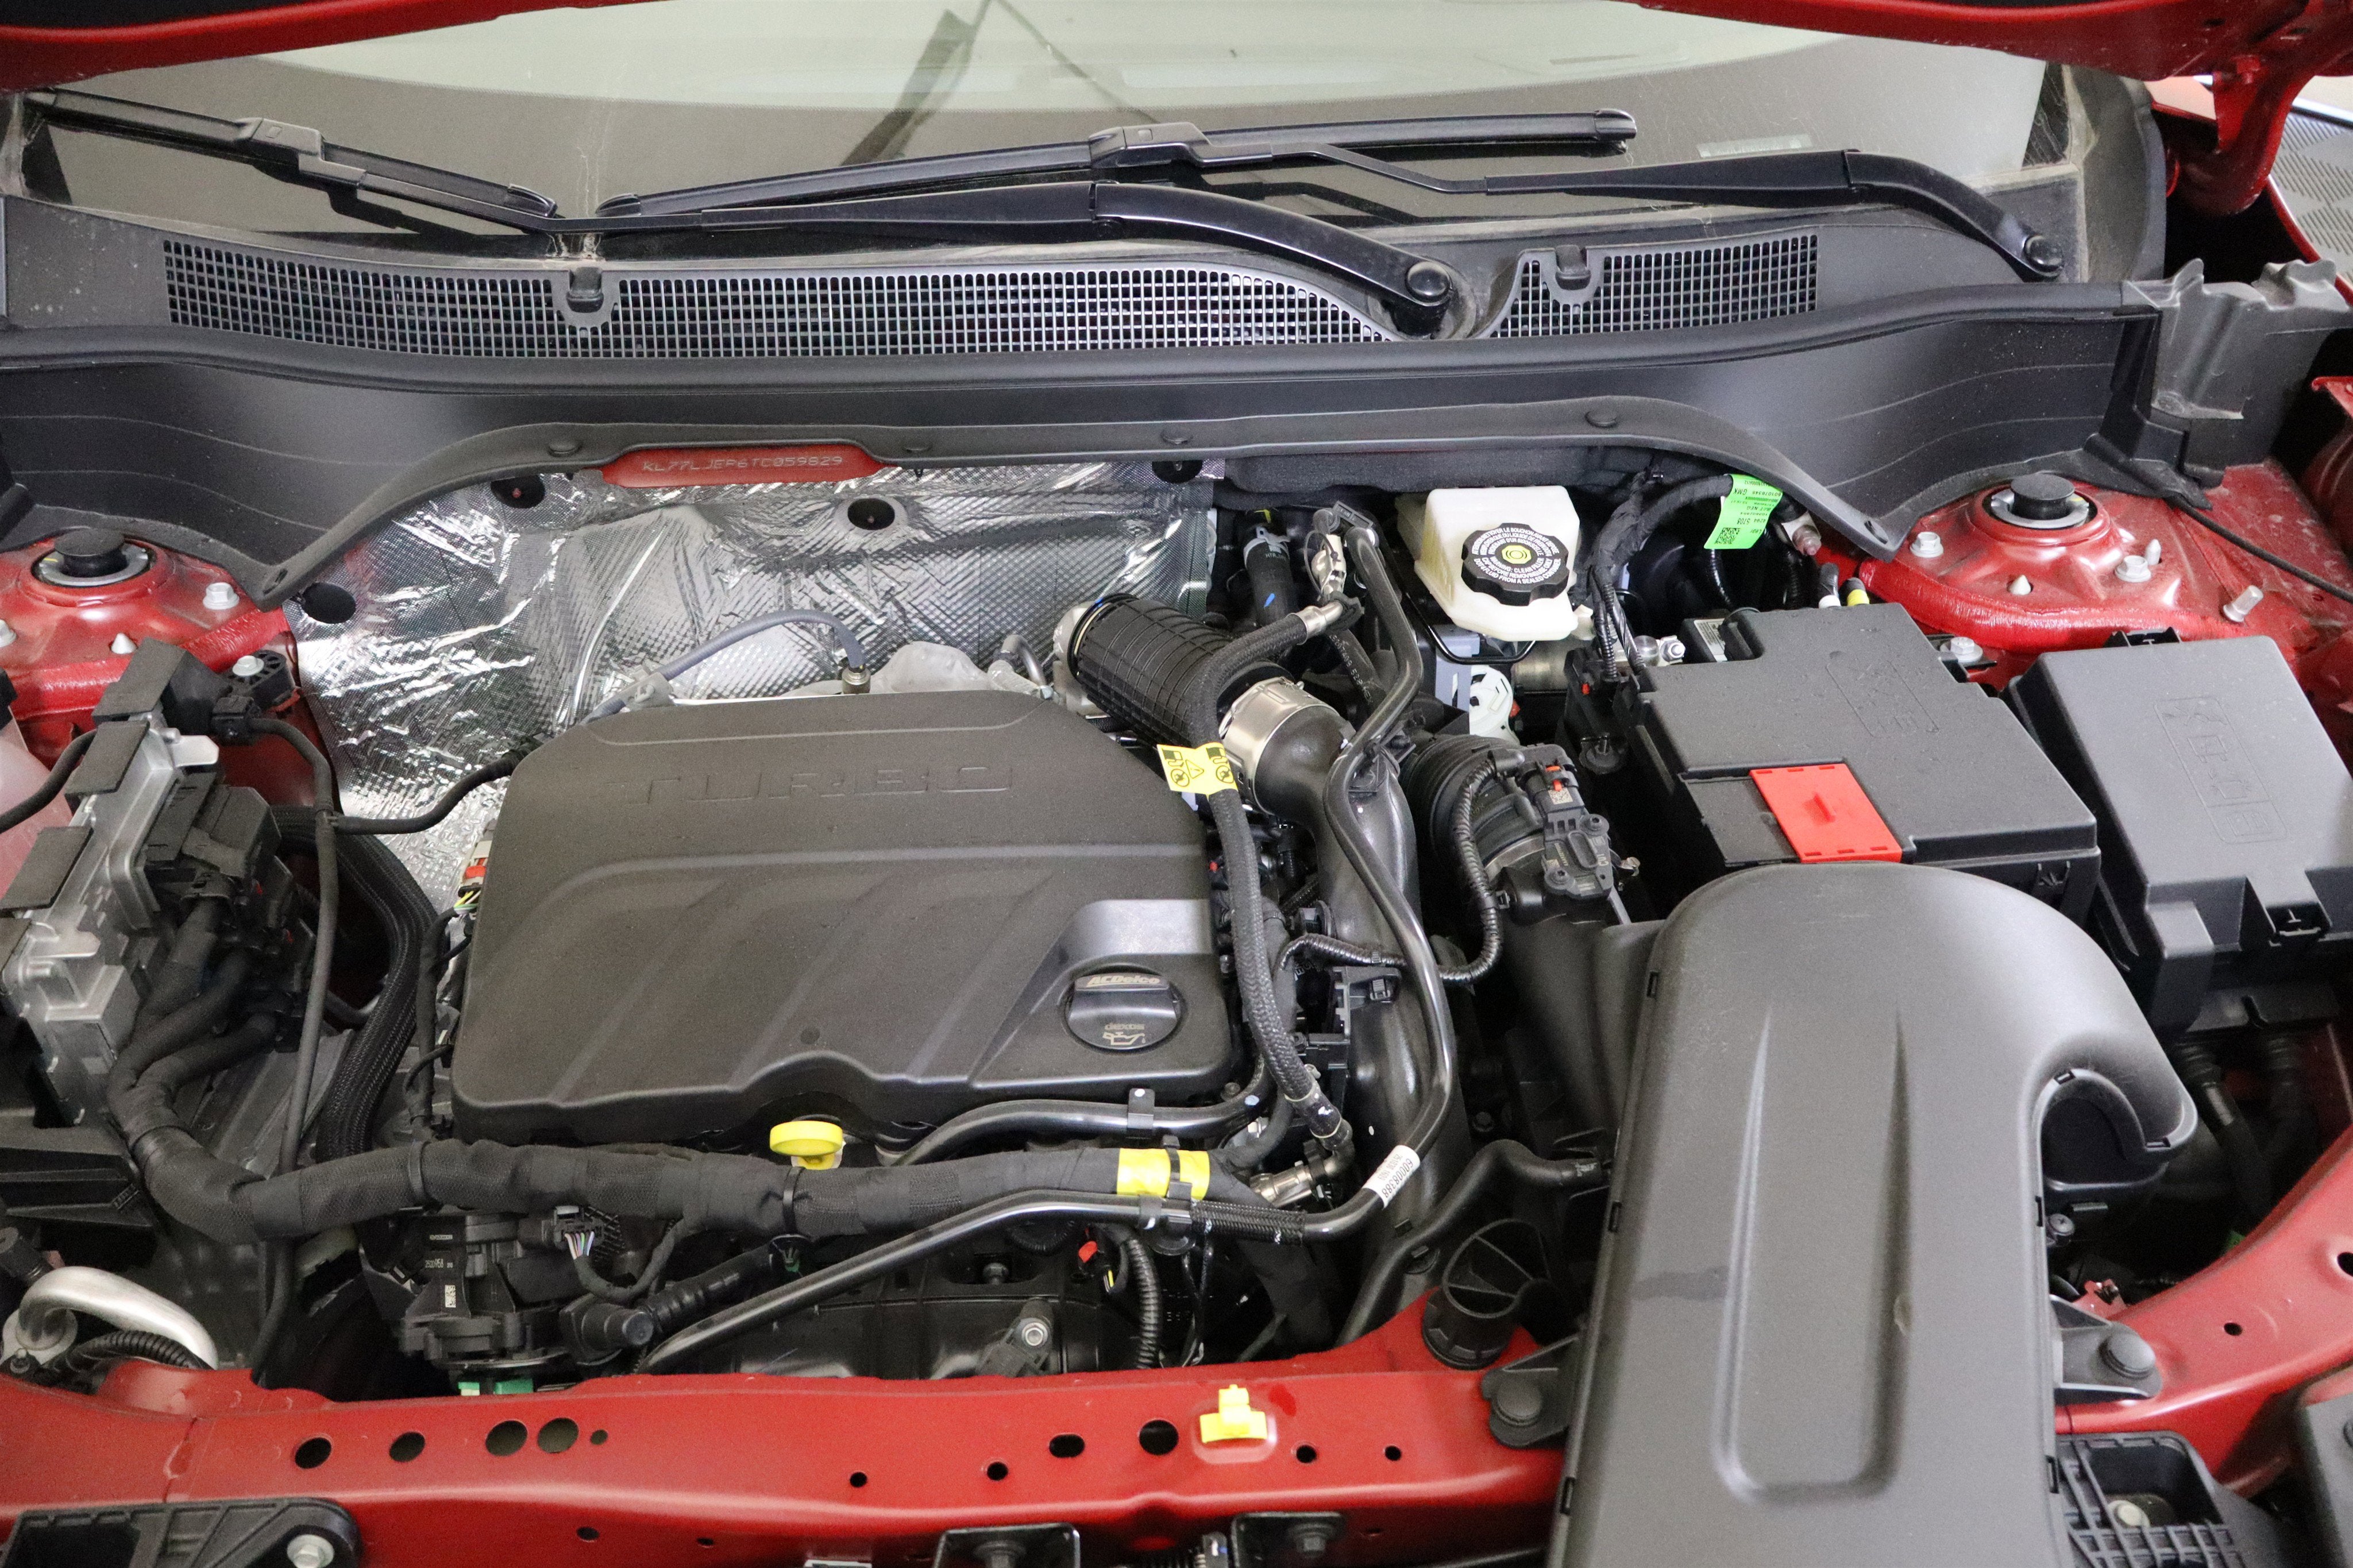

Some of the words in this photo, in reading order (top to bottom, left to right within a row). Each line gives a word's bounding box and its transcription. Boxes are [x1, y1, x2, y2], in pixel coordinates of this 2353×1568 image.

[1483, 566, 1498, 578] FLUID
[1488, 564, 1509, 577] BEFORE
[605, 767, 1012, 805] TURBO
[1086, 975, 1160, 986] ACDelco
